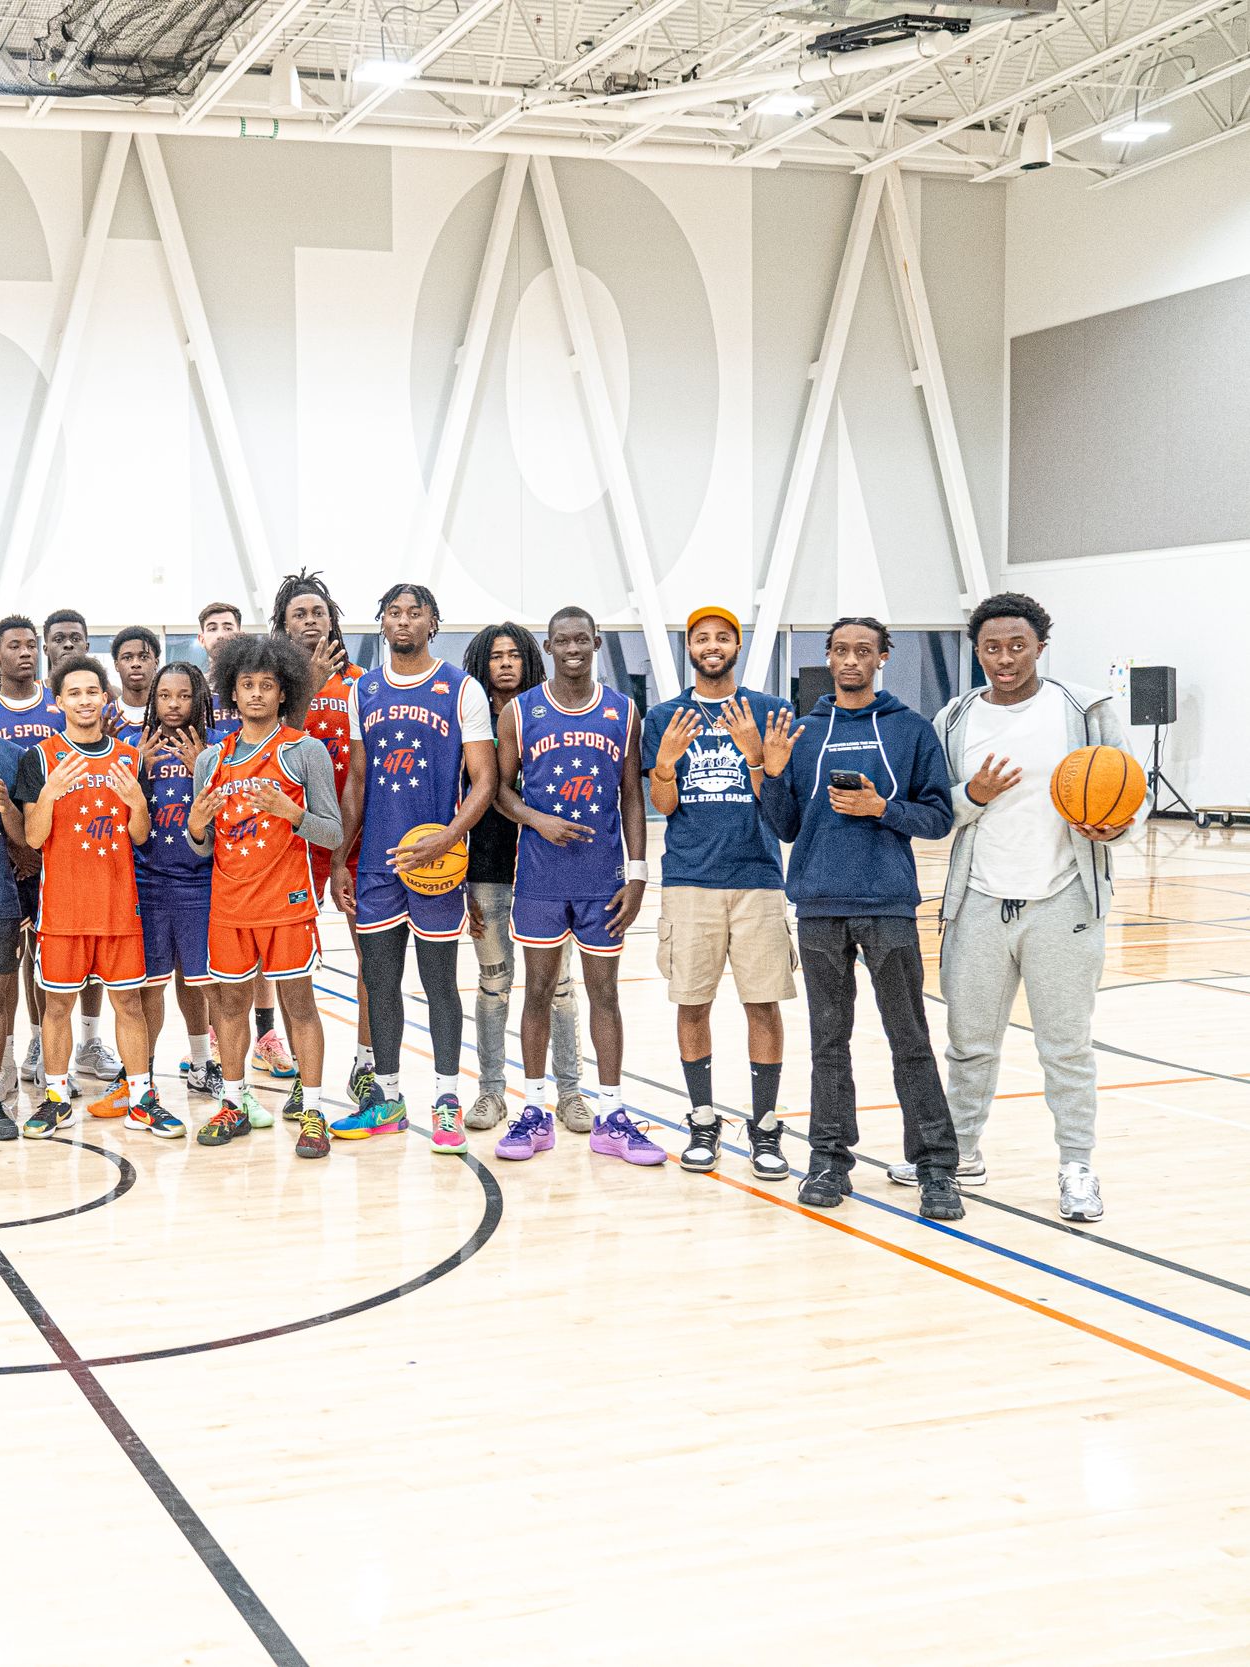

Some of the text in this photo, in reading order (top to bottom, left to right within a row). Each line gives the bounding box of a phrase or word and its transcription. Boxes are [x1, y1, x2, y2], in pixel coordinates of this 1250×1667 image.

[310, 697, 348, 713] SPOR
[14, 724, 58, 738] SPOR
[388, 704, 450, 738] SPORTS
[530, 731, 621, 762] MOL SPORTS
[383, 748, 415, 775] 4T4
[86, 774, 118, 788] SPO
[160, 765, 194, 779] SPO
[559, 775, 594, 802] 4T4
[698, 793, 724, 802] STAR
[725, 793, 753, 803] GAME
[155, 803, 185, 829] 4T4
[86, 815, 113, 840] 4T4
[406, 876, 454, 892] Wilson
